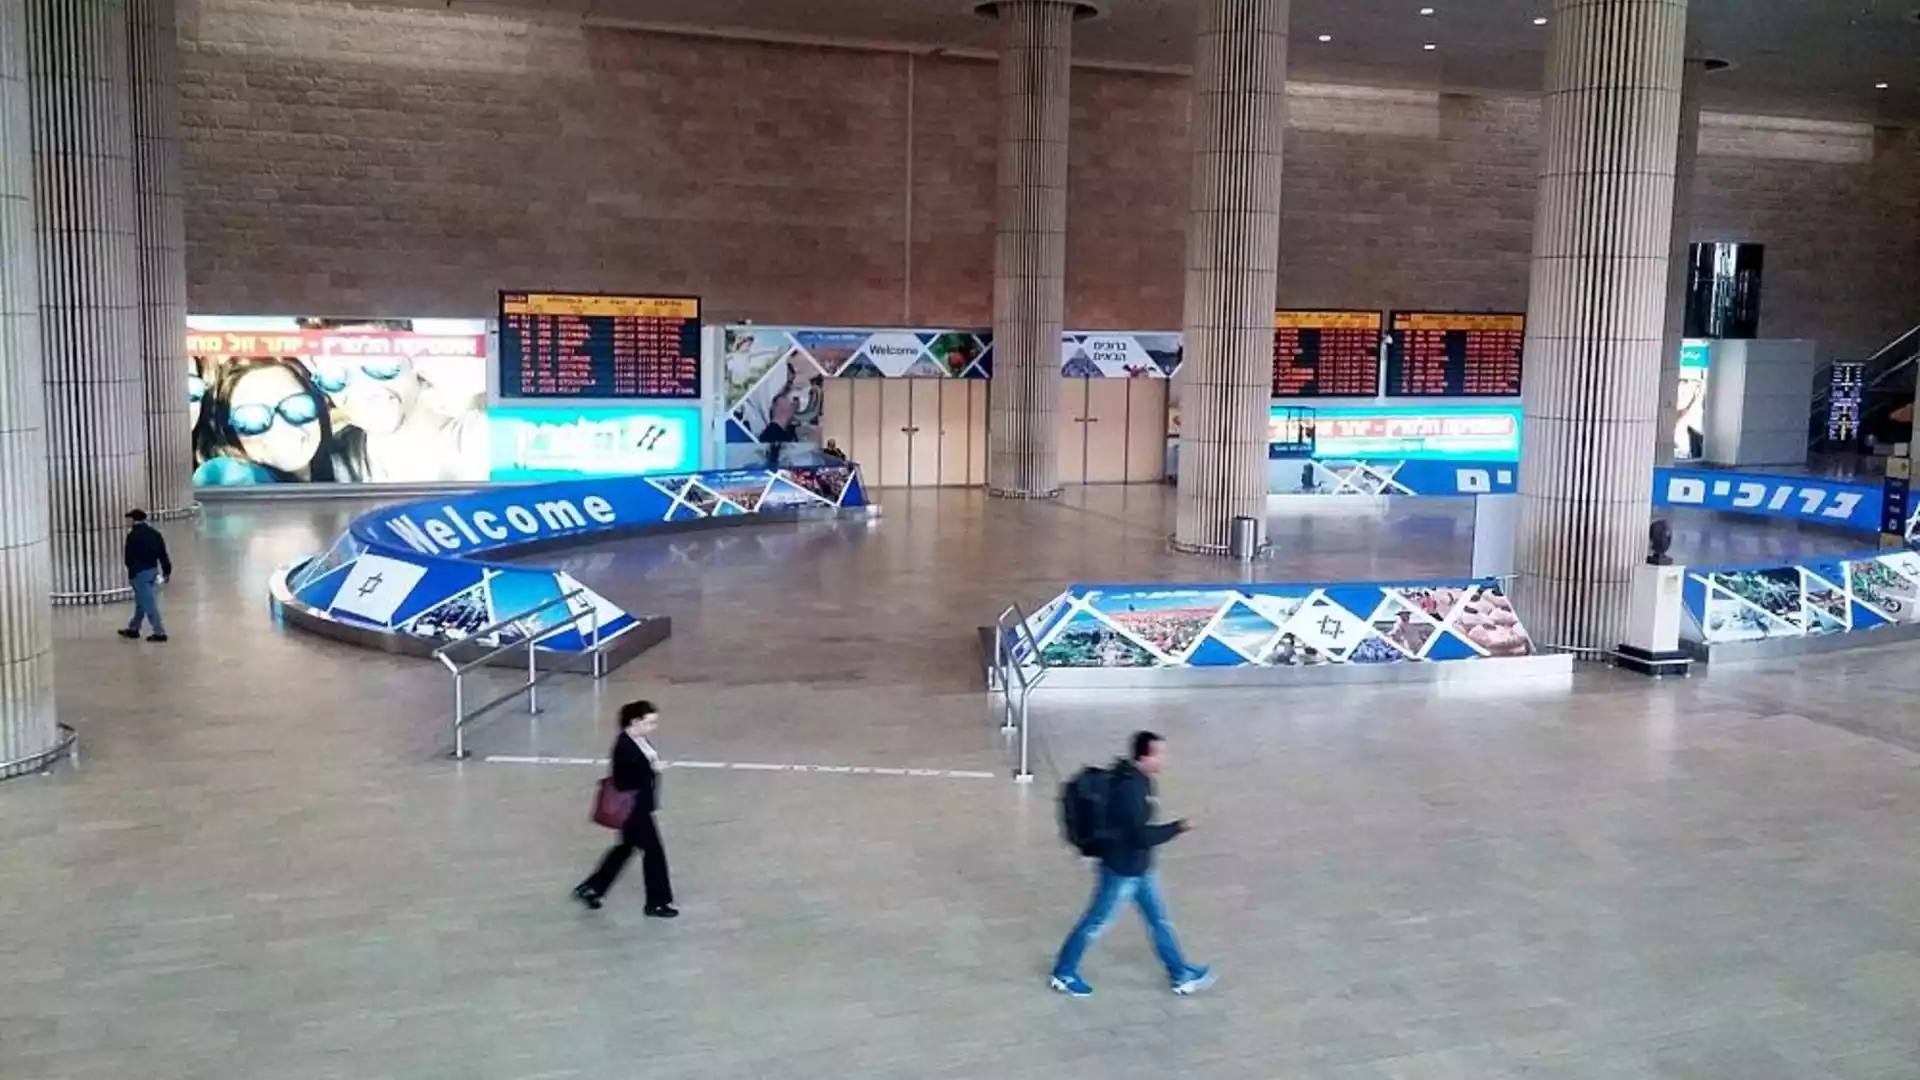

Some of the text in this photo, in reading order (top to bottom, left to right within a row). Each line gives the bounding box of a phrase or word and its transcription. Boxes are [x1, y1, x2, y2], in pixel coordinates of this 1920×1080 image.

[869, 344, 918, 355] Welcome
[1093, 341, 1127, 351] ברוכים
[1093, 352, 1127, 362] הבאים
[1668, 479, 1863, 518] ברוכים
[385, 493, 616, 556] Welcome
